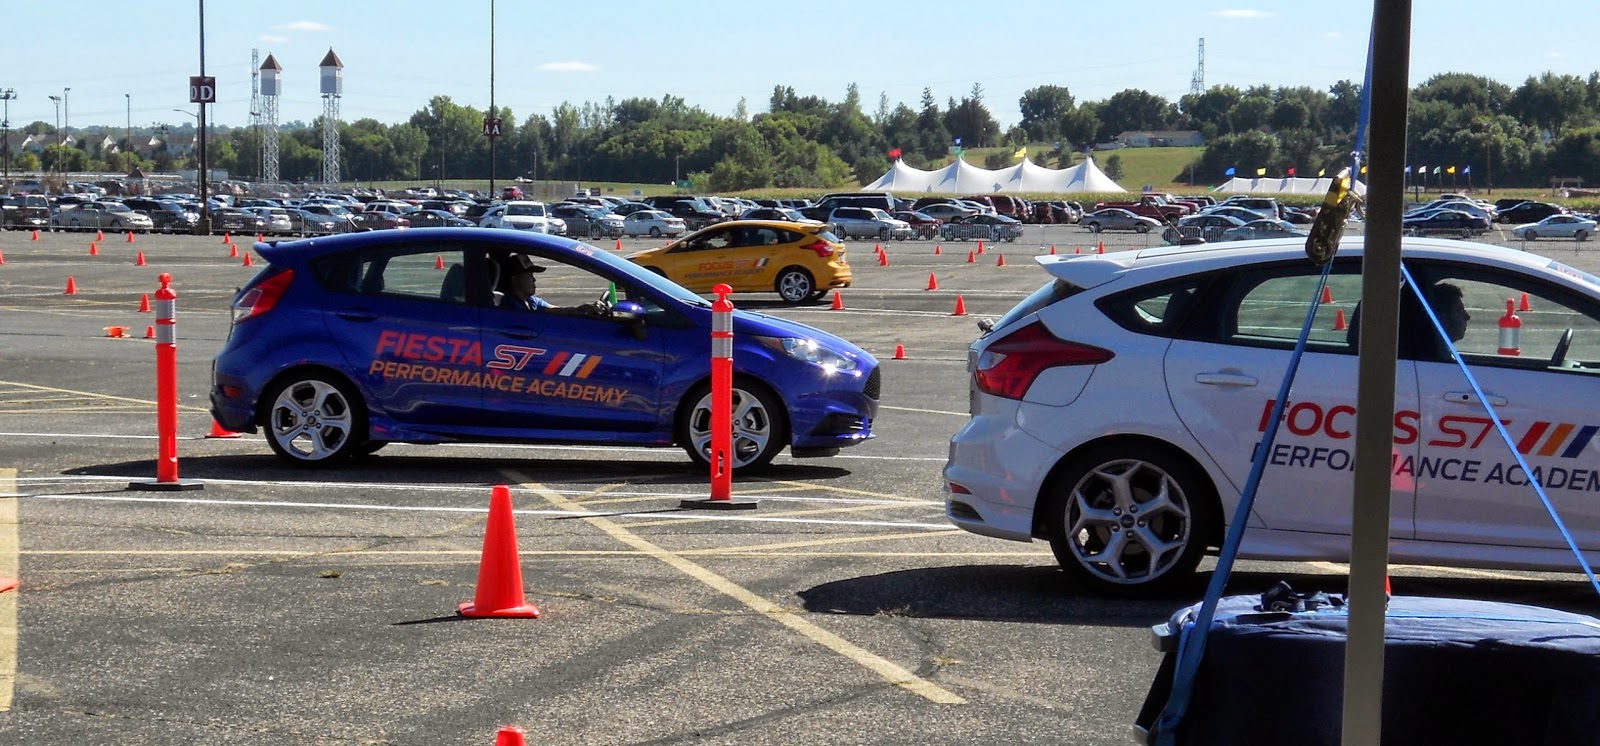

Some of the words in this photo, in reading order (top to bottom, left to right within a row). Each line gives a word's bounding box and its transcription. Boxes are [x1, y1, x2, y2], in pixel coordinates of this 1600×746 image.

[698, 260, 732, 271] FOCUS
[375, 330, 482, 366] FIESTA
[487, 344, 547, 371] ST
[369, 360, 525, 393] PERFORMANCE
[526, 379, 628, 405] ACADEMY
[1258, 399, 1421, 445] FOCS
[1428, 414, 1511, 449] ST
[1250, 442, 1481, 483] ERFOANCE
